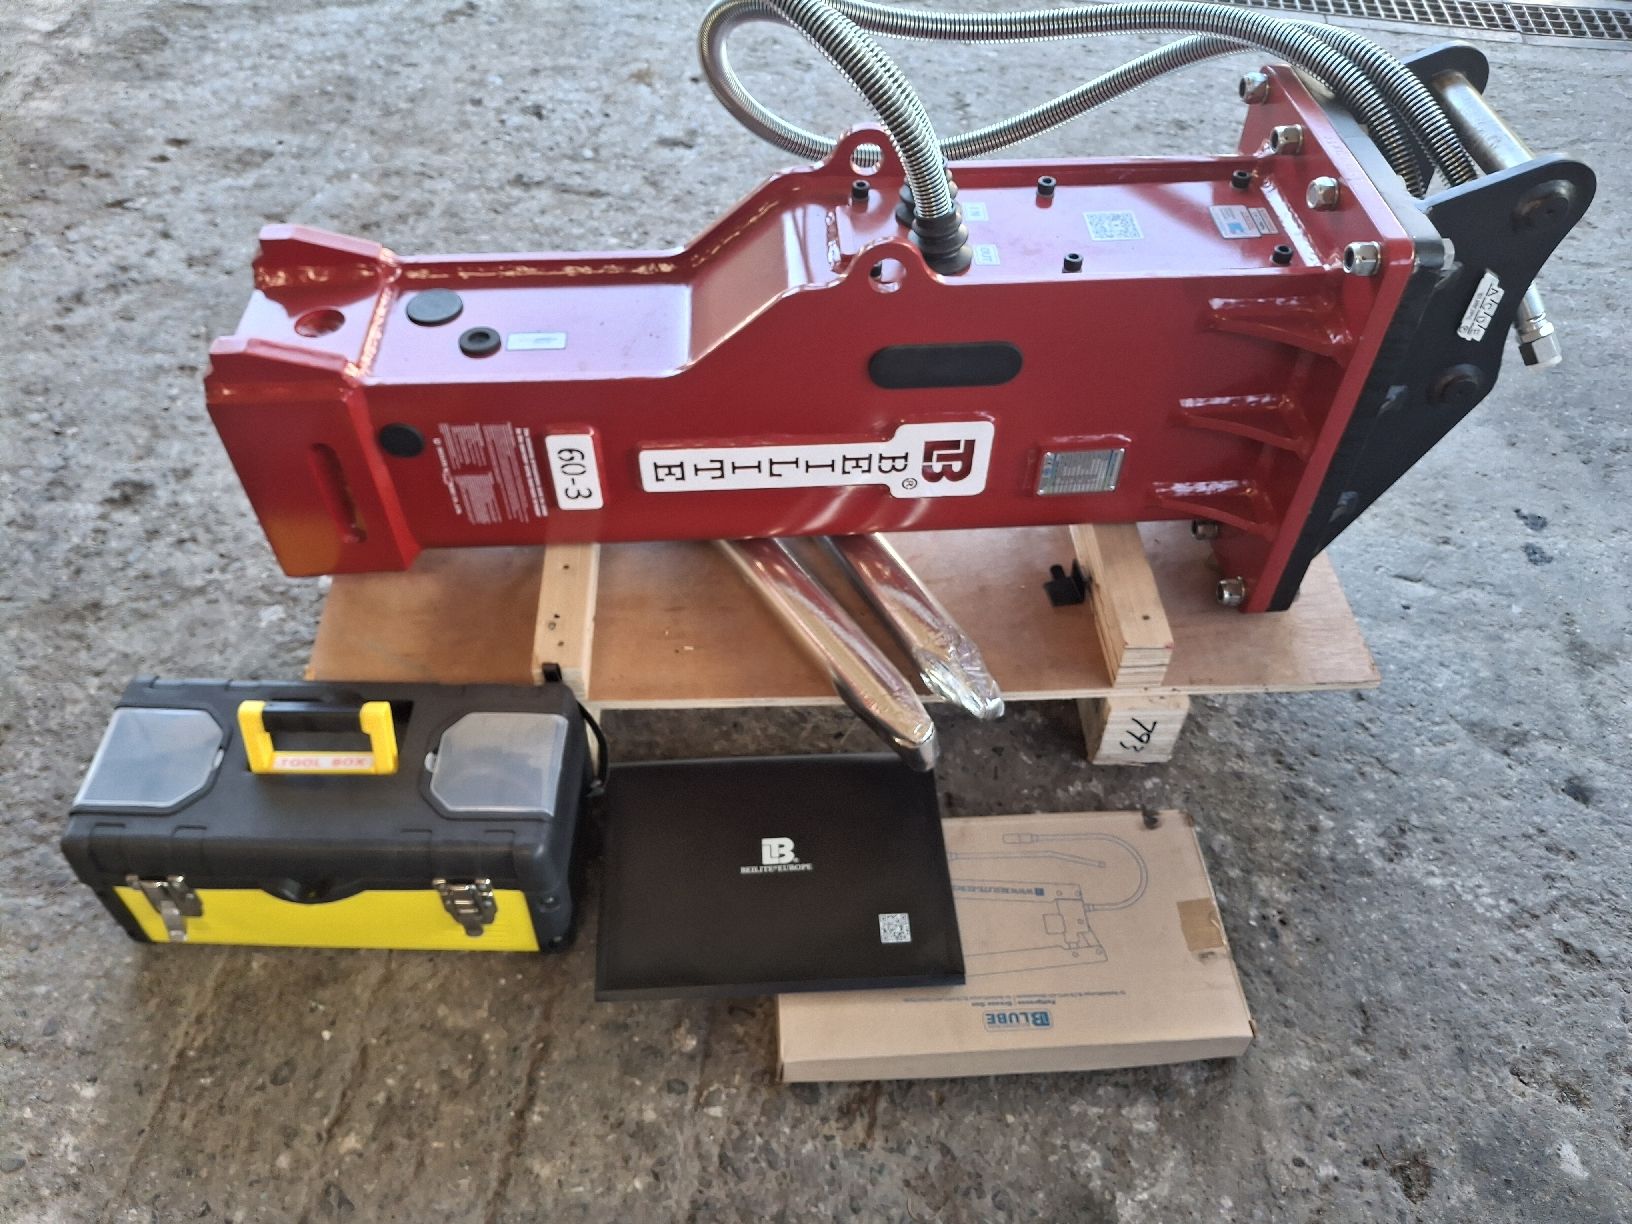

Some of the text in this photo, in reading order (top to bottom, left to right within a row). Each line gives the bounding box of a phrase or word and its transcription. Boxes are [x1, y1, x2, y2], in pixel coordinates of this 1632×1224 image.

[557, 447, 592, 500] 60-3
[653, 452, 909, 483] BEILITE
[1119, 717, 1157, 752] 793
[281, 757, 367, 768] TOOL BOX
